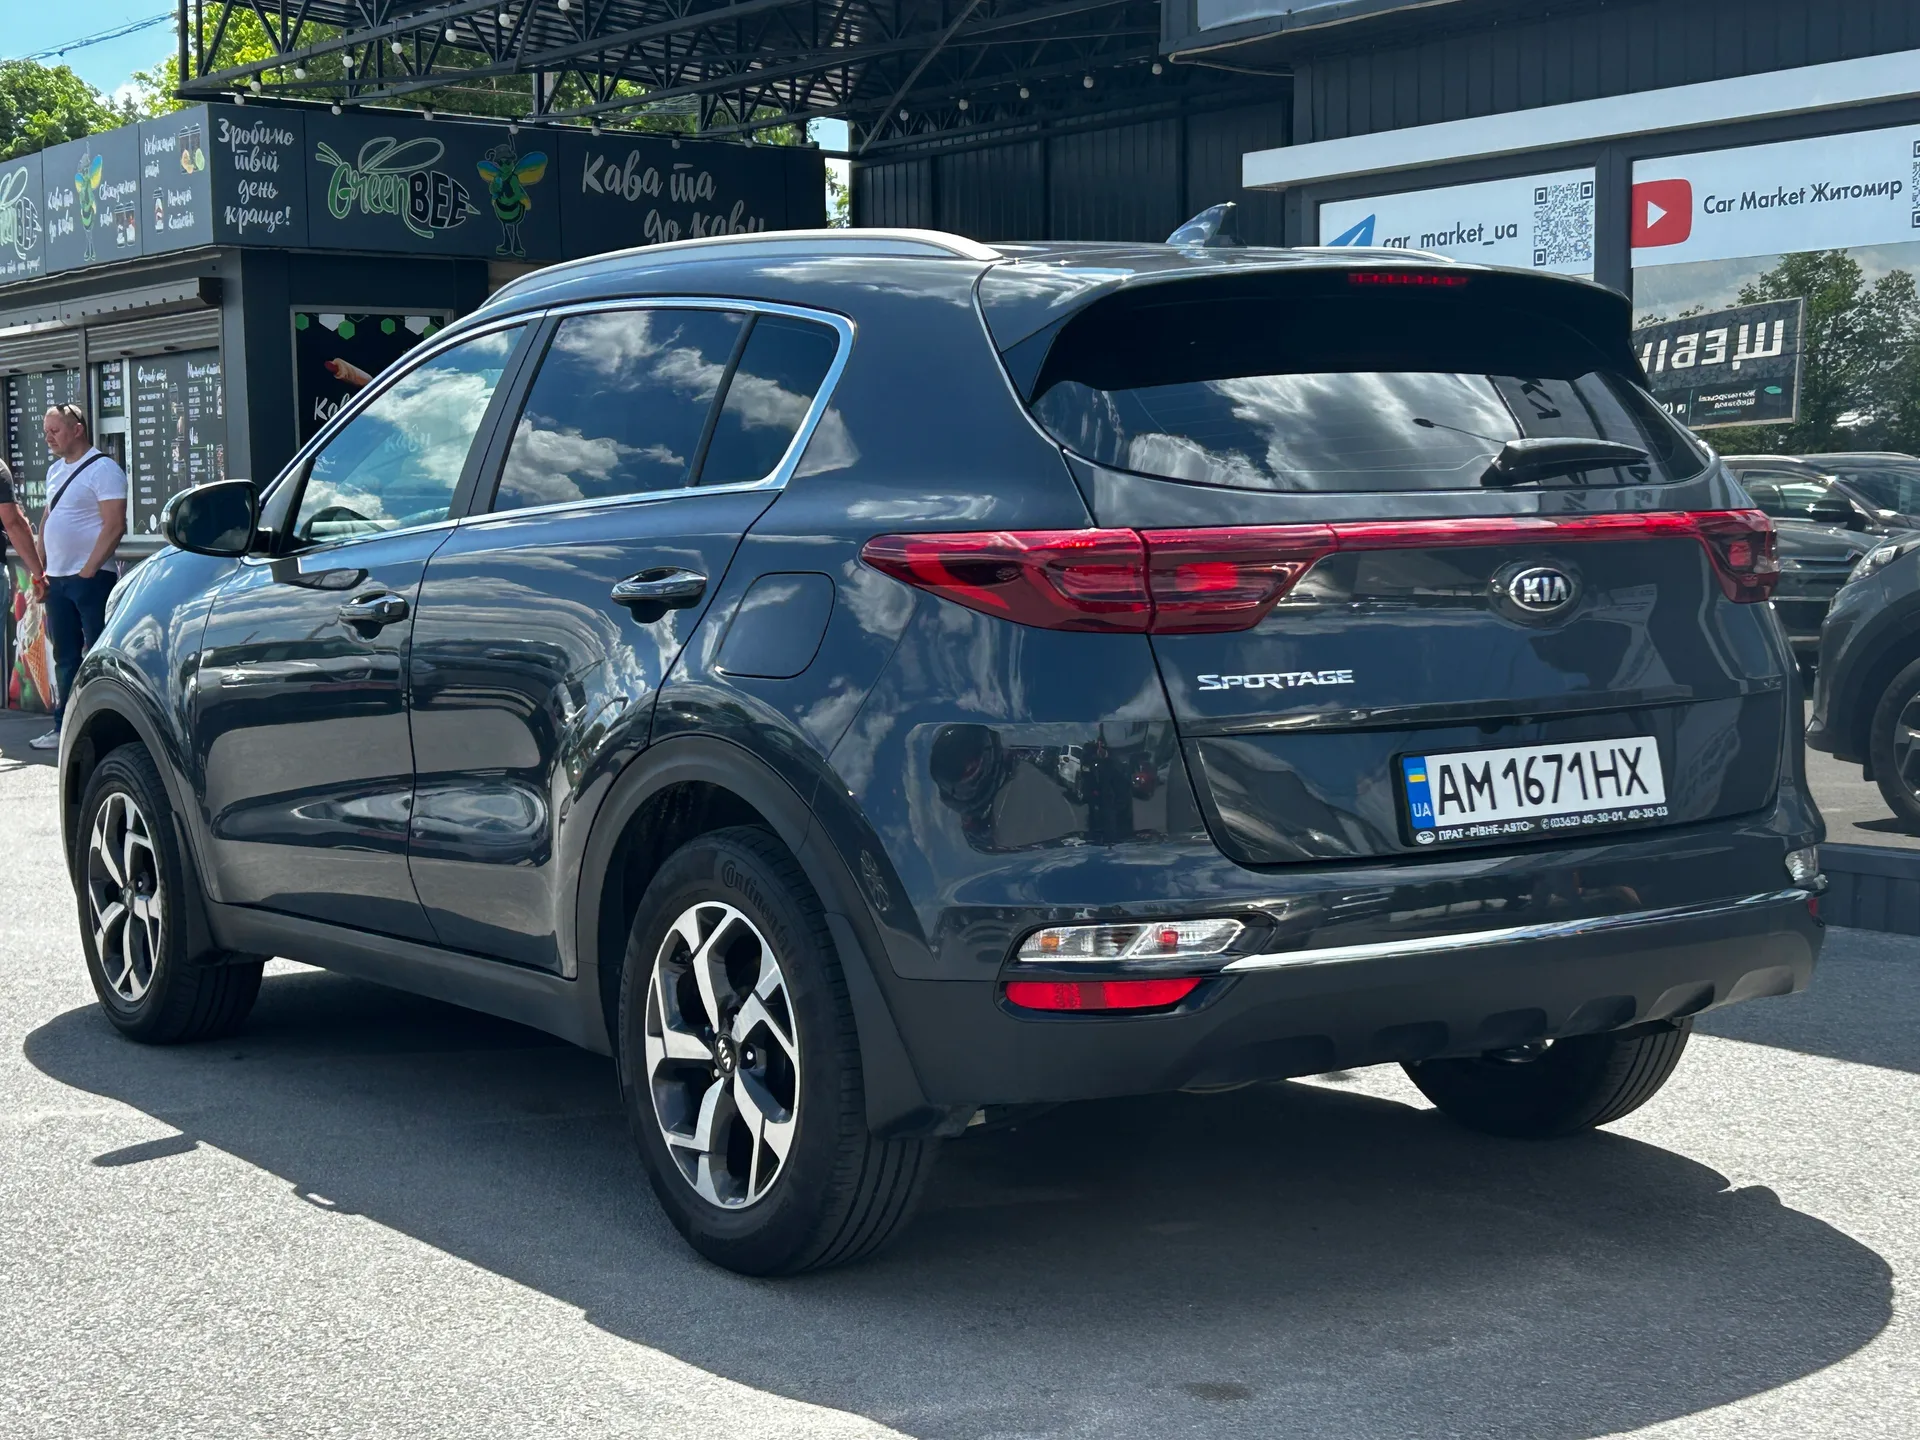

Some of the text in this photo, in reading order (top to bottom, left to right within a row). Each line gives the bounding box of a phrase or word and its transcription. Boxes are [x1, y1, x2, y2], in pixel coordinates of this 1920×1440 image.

[217, 117, 295, 152] Зробимо
[234, 149, 280, 173] твій
[582, 150, 717, 203] Кава та
[238, 180, 279, 204] день
[1703, 180, 1903, 215] Car Market Житомир
[224, 205, 292, 235] краще!
[644, 209, 681, 244] до
[1383, 221, 1518, 249] carmarket_ua
[1523, 576, 1568, 603] KIA
[1197, 669, 1355, 691] SPORTAGE
[1412, 803, 1431, 818] UA
[717, 1038, 732, 1070] KIA
